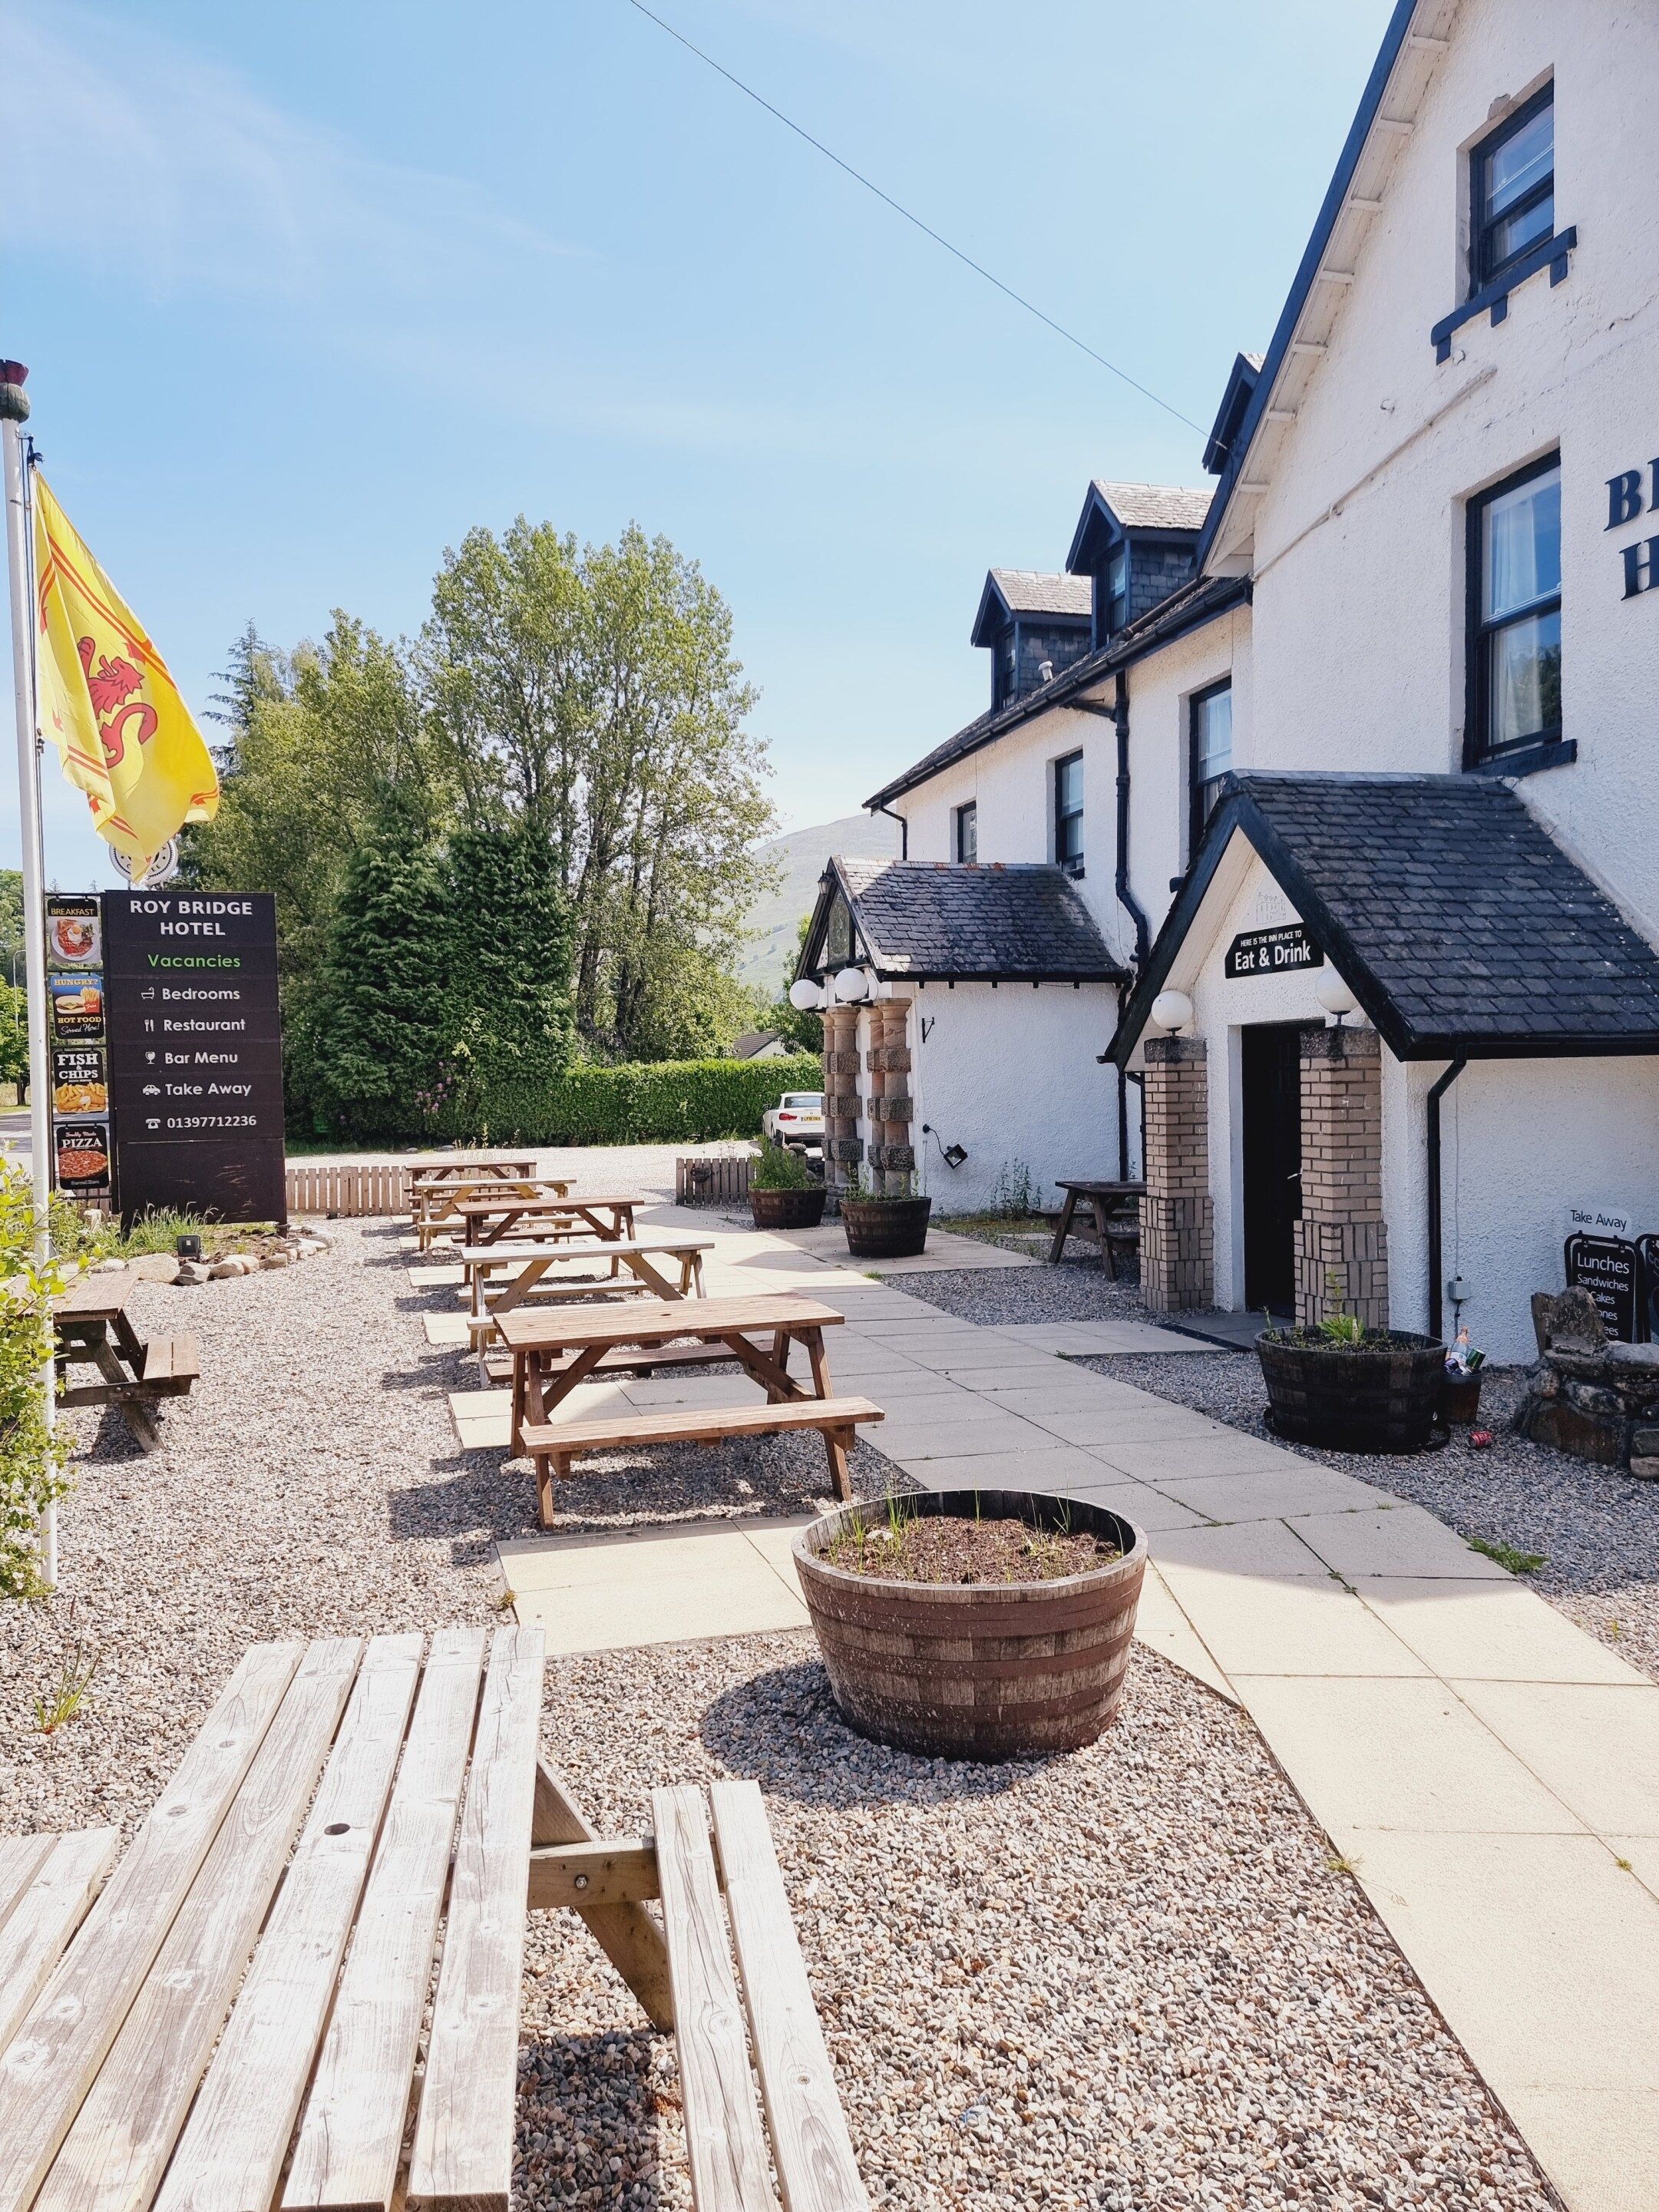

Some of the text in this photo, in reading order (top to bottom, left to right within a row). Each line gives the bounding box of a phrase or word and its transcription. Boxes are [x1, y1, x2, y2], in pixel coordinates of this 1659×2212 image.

[130, 900, 253, 915] ROY BRIDGE
[160, 921, 226, 936] HOTEL
[1241, 938, 1252, 947] HERE
[1258, 936, 1268, 944] THE
[1278, 931, 1294, 941] PLACE
[147, 954, 241, 967] Vacancies
[1235, 940, 1310, 970] Eat & Drink
[162, 987, 240, 1000] Bedrooms
[164, 1019, 246, 1031] Restaurant
[57, 1053, 99, 1066] FISH
[165, 1051, 238, 1064] Bar Menu
[58, 1070, 98, 1080] CHIPS
[165, 1083, 252, 1096] Take Away
[167, 1116, 256, 1129] 01397712236
[61, 1137, 103, 1149] PIZZA
[1570, 1209, 1628, 1232] Take Away
[1577, 1252, 1630, 1275] Lunches
[1577, 1274, 1629, 1292] Sandwiches
